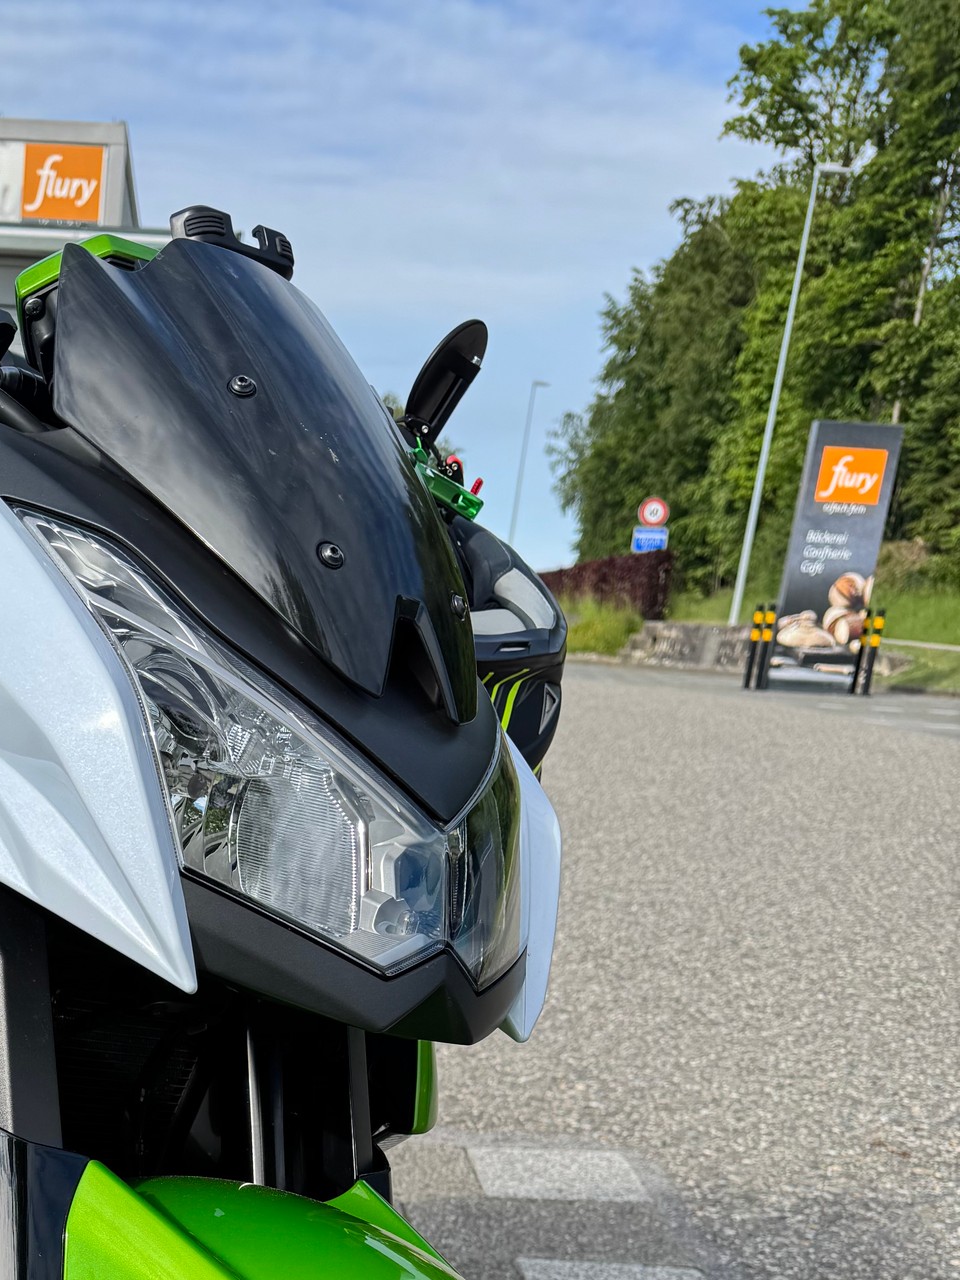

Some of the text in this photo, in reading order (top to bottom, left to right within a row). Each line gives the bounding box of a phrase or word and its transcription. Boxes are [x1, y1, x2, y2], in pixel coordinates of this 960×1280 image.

[24, 154, 98, 213] flury
[818, 455, 879, 498] flury
[806, 529, 850, 545] Bäckerei
